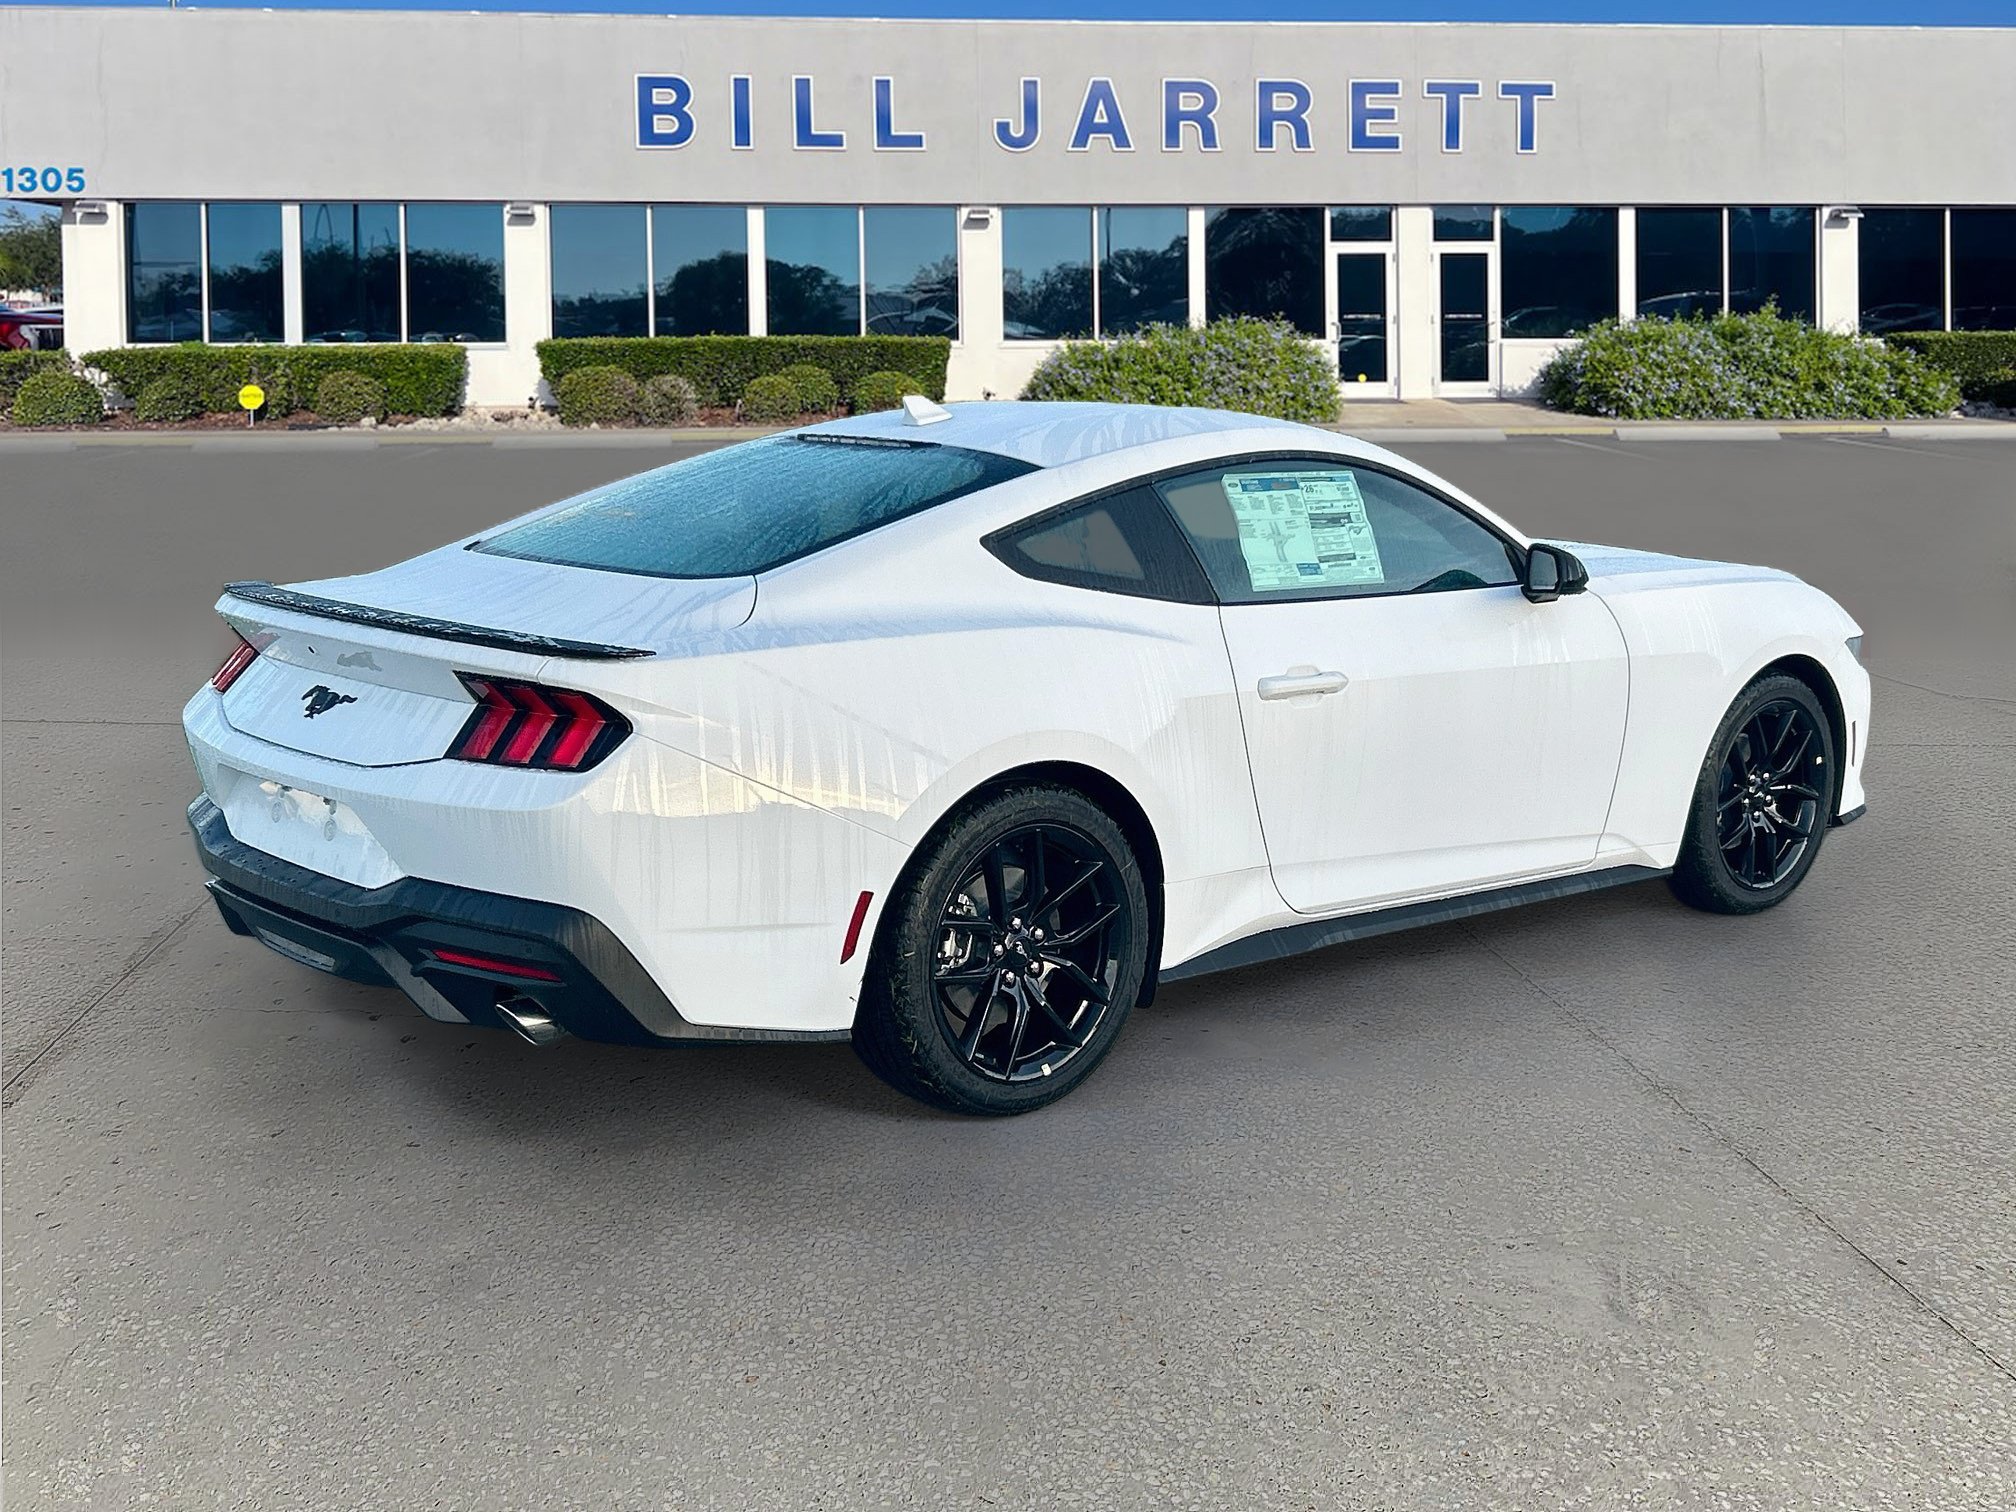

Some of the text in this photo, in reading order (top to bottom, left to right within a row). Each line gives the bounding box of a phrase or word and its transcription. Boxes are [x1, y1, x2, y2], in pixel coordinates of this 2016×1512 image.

[635, 73, 1556, 153] BILL JARRETT
[1, 166, 86, 193] 1305
